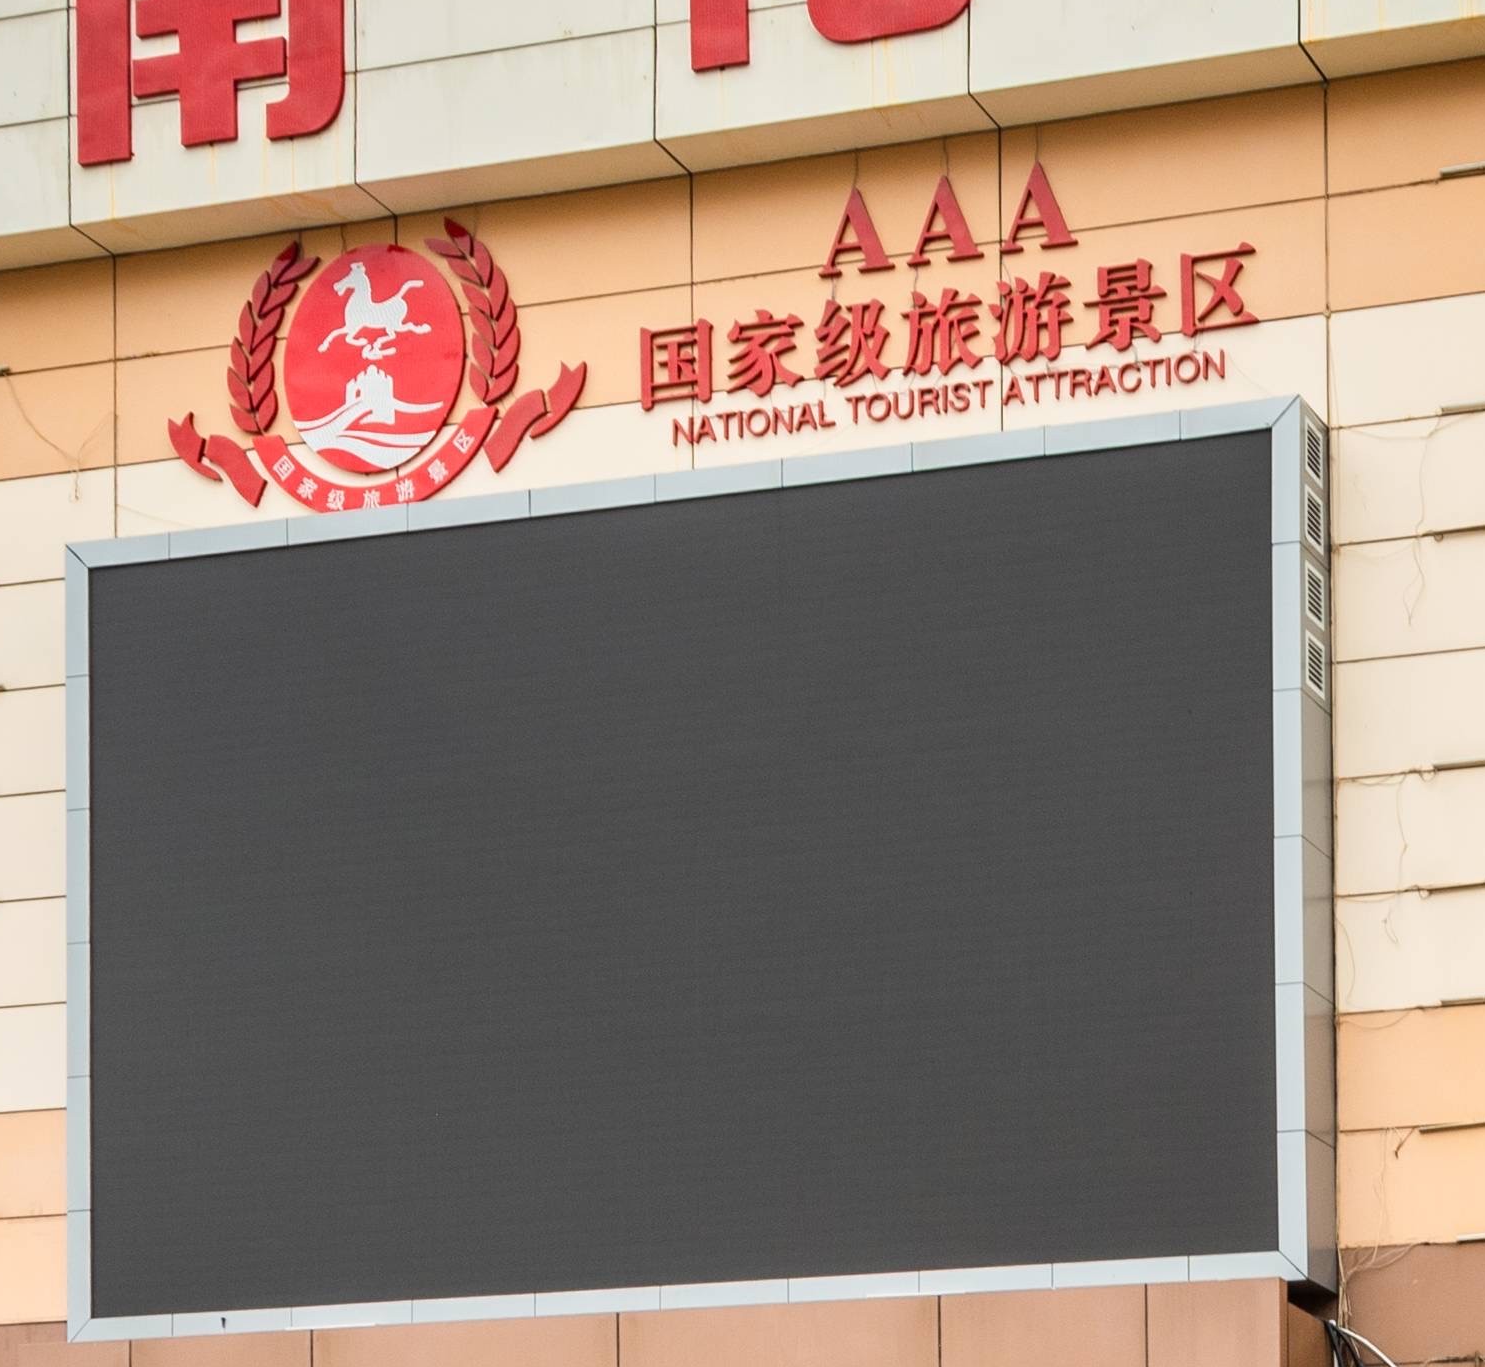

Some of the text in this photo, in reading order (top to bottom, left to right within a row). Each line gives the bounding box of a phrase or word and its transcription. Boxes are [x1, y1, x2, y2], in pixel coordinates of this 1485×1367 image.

[819, 161, 1077, 279] AAA
[636, 240, 1261, 414] 国家级旅游景区
[672, 349, 1228, 447] NATIONAL TOURIST ATTRACTION
[272, 429, 476, 510] 国家级旅游景区
